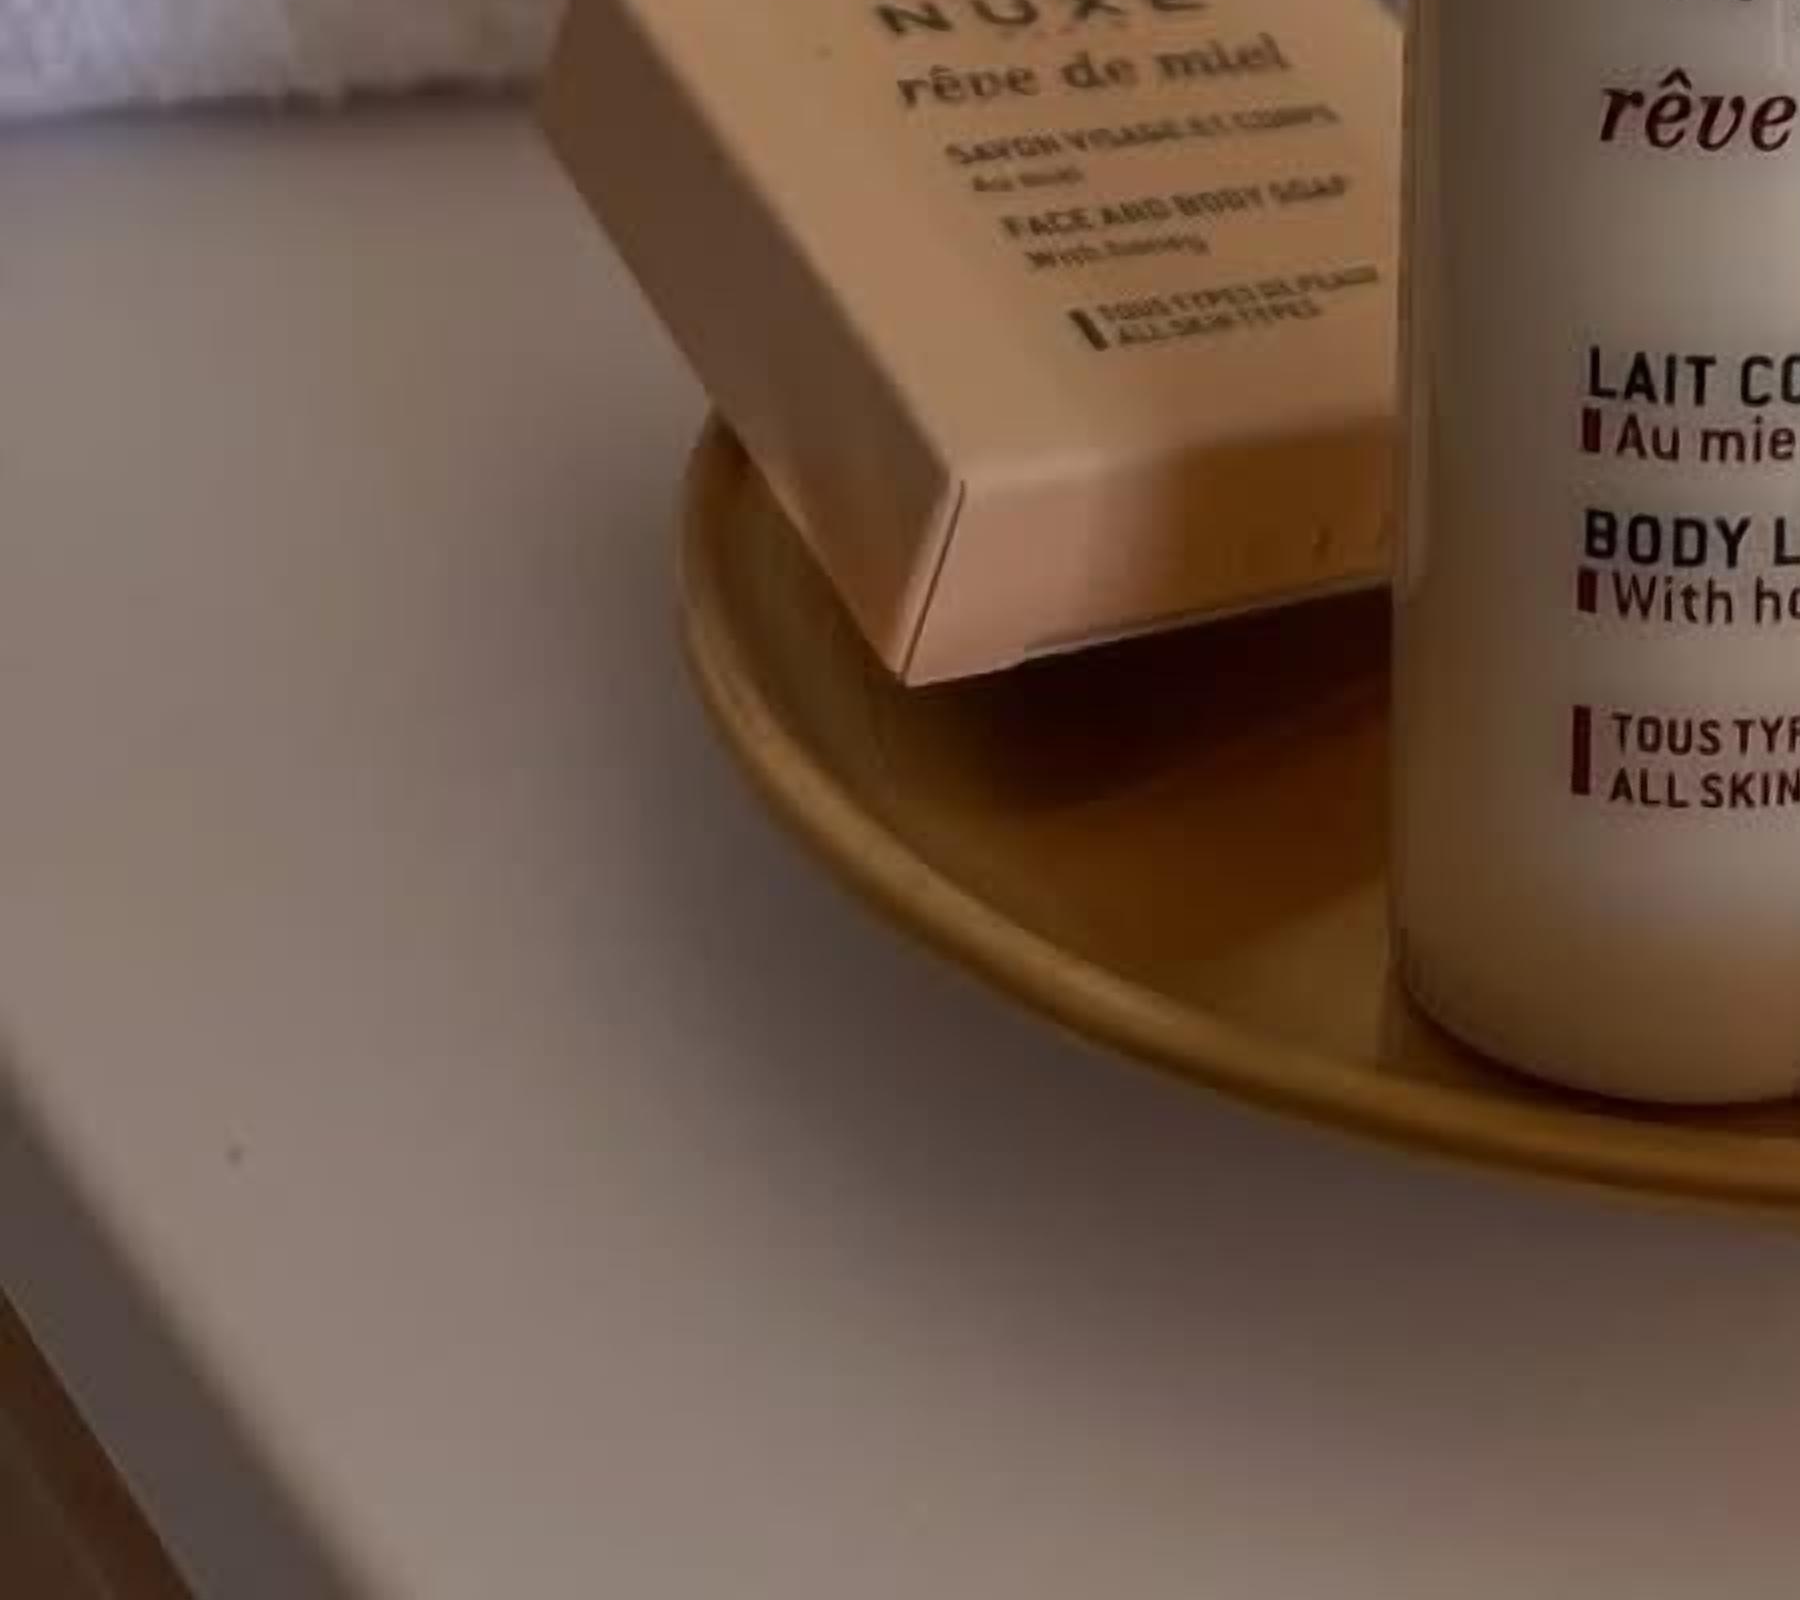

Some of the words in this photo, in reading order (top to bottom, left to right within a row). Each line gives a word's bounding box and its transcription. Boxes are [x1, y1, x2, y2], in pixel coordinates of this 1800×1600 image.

[897, 64, 1041, 109] rêve
[1063, 50, 1138, 90] de
[1158, 32, 1292, 81] miel
[1600, 67, 1797, 153] rêve
[1002, 208, 1092, 238] FACE
[1588, 345, 1717, 407] LAIT
[1615, 420, 1682, 463] Au
[1583, 508, 1751, 570] BODY
[1610, 570, 1734, 625] With
[1610, 710, 1721, 756] TOUS
[1609, 767, 1690, 810] ALL
